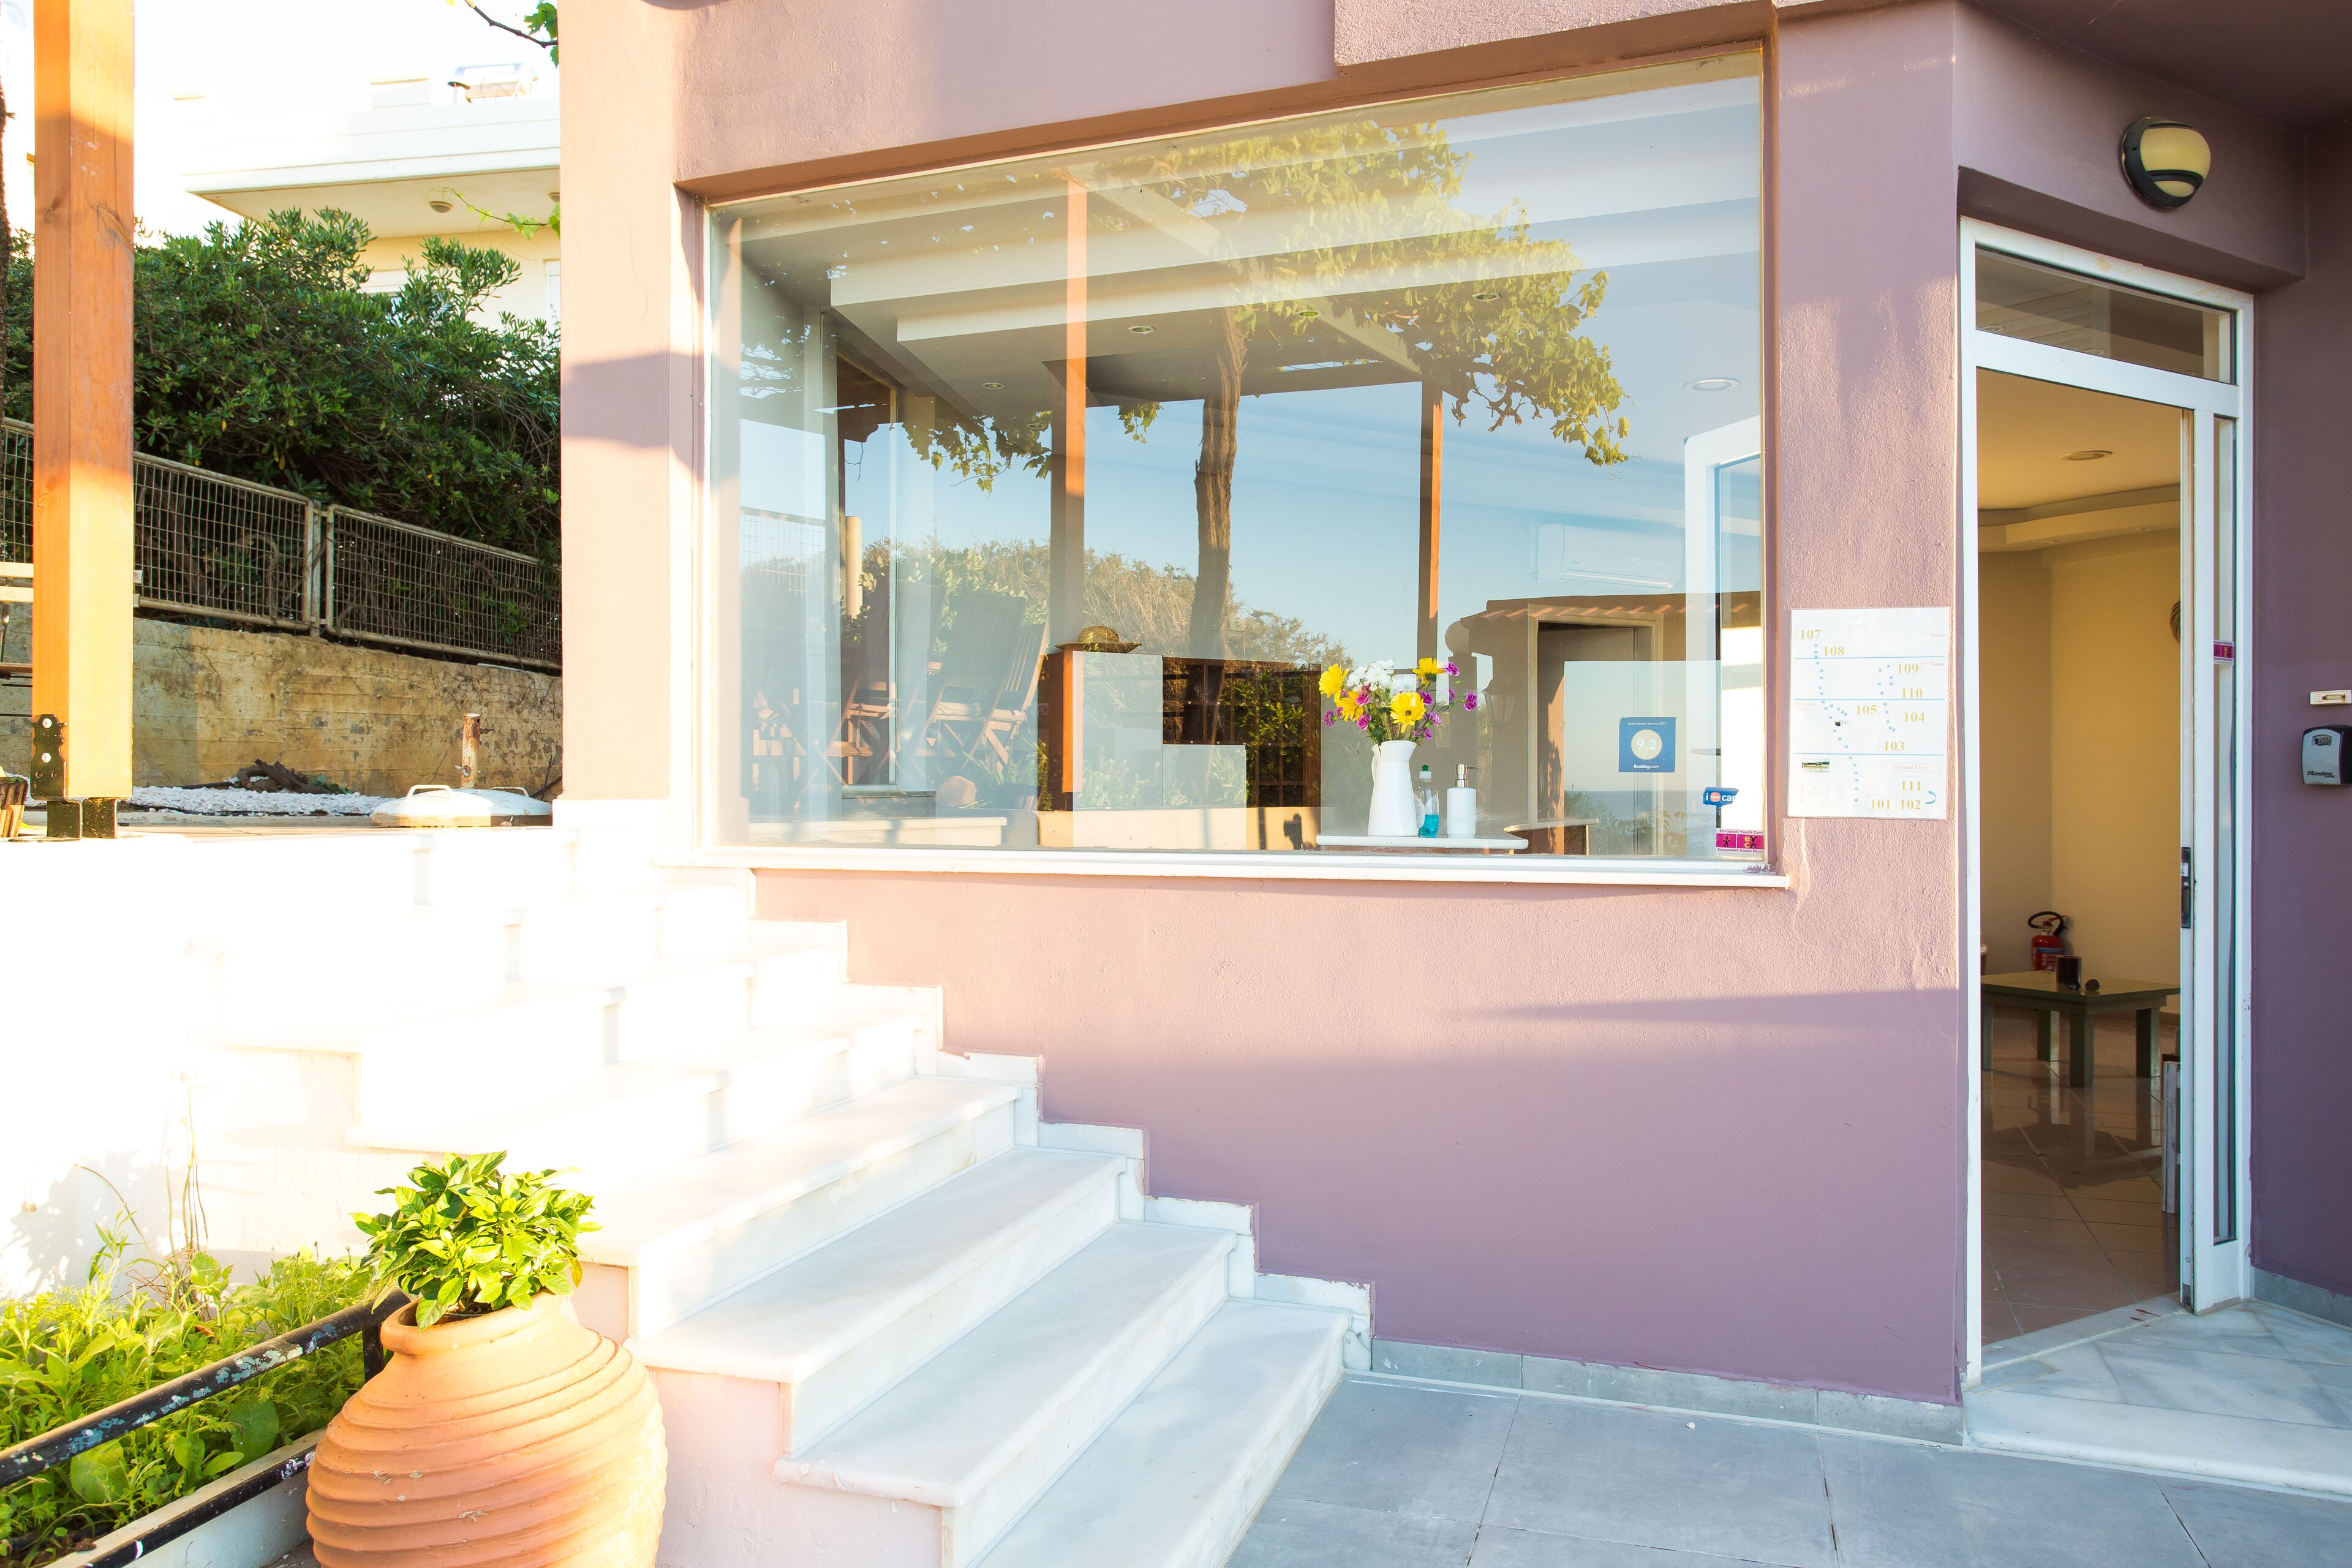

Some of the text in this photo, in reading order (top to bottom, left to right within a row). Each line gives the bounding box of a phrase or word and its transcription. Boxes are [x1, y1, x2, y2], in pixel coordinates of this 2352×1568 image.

[1800, 629, 1821, 639] 107
[1824, 646, 1845, 657] 108
[1898, 663, 1919, 674] 109
[1902, 688, 1923, 698] 110
[1856, 704, 1877, 715] 105
[1904, 712, 1925, 722] 104
[1636, 739, 1657, 751] 9,2
[1884, 741, 1905, 752] 103
[1901, 780, 1921, 791] 111
[1871, 799, 1891, 810] 101
[1901, 799, 1921, 810] 102
